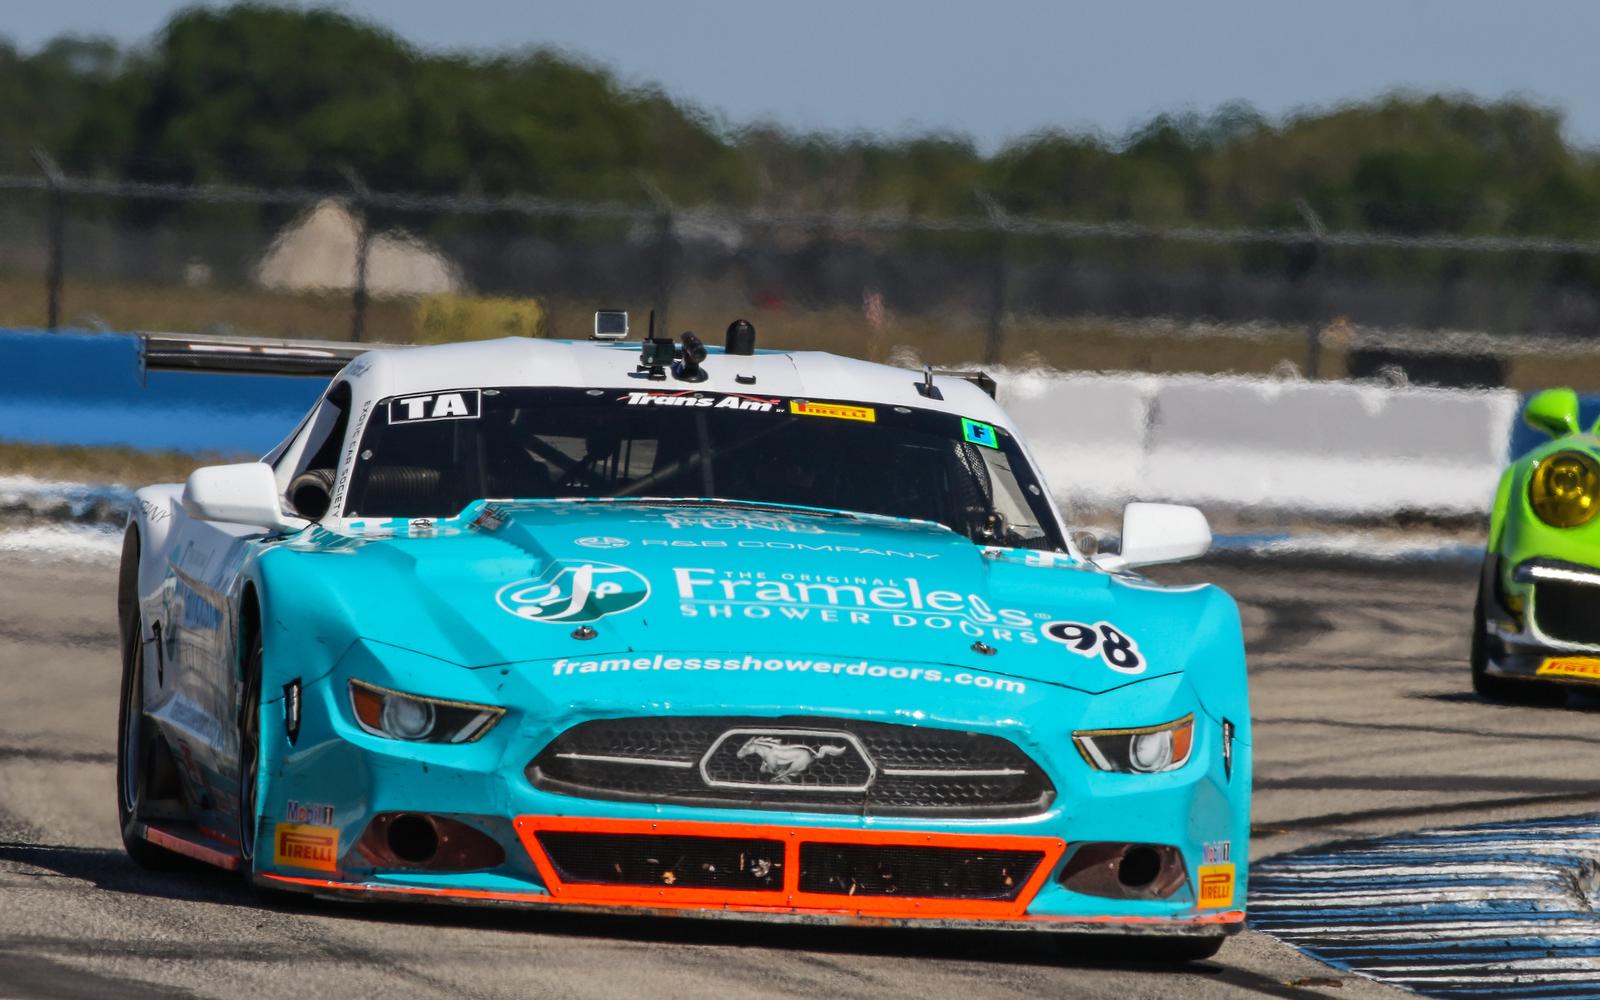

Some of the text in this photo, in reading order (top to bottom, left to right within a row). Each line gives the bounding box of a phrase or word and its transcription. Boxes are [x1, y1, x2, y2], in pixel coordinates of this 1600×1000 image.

[399, 393, 468, 420] TA
[627, 391, 713, 408] Trans
[716, 396, 772, 412] Am
[799, 401, 867, 419] PIRELLI
[972, 424, 985, 439] F
[332, 469, 349, 518] SOCIETY
[738, 540, 941, 559] COMPANY
[723, 570, 899, 588] THE ORIGINAL
[672, 566, 1034, 628] Frameless
[679, 603, 1040, 645] SHOWER DOORS
[1043, 622, 1145, 673] 98
[551, 654, 1027, 694] framelessshowerdoors.com
[280, 831, 334, 862] PIRELLI
[1201, 873, 1232, 900] PIRELLI
